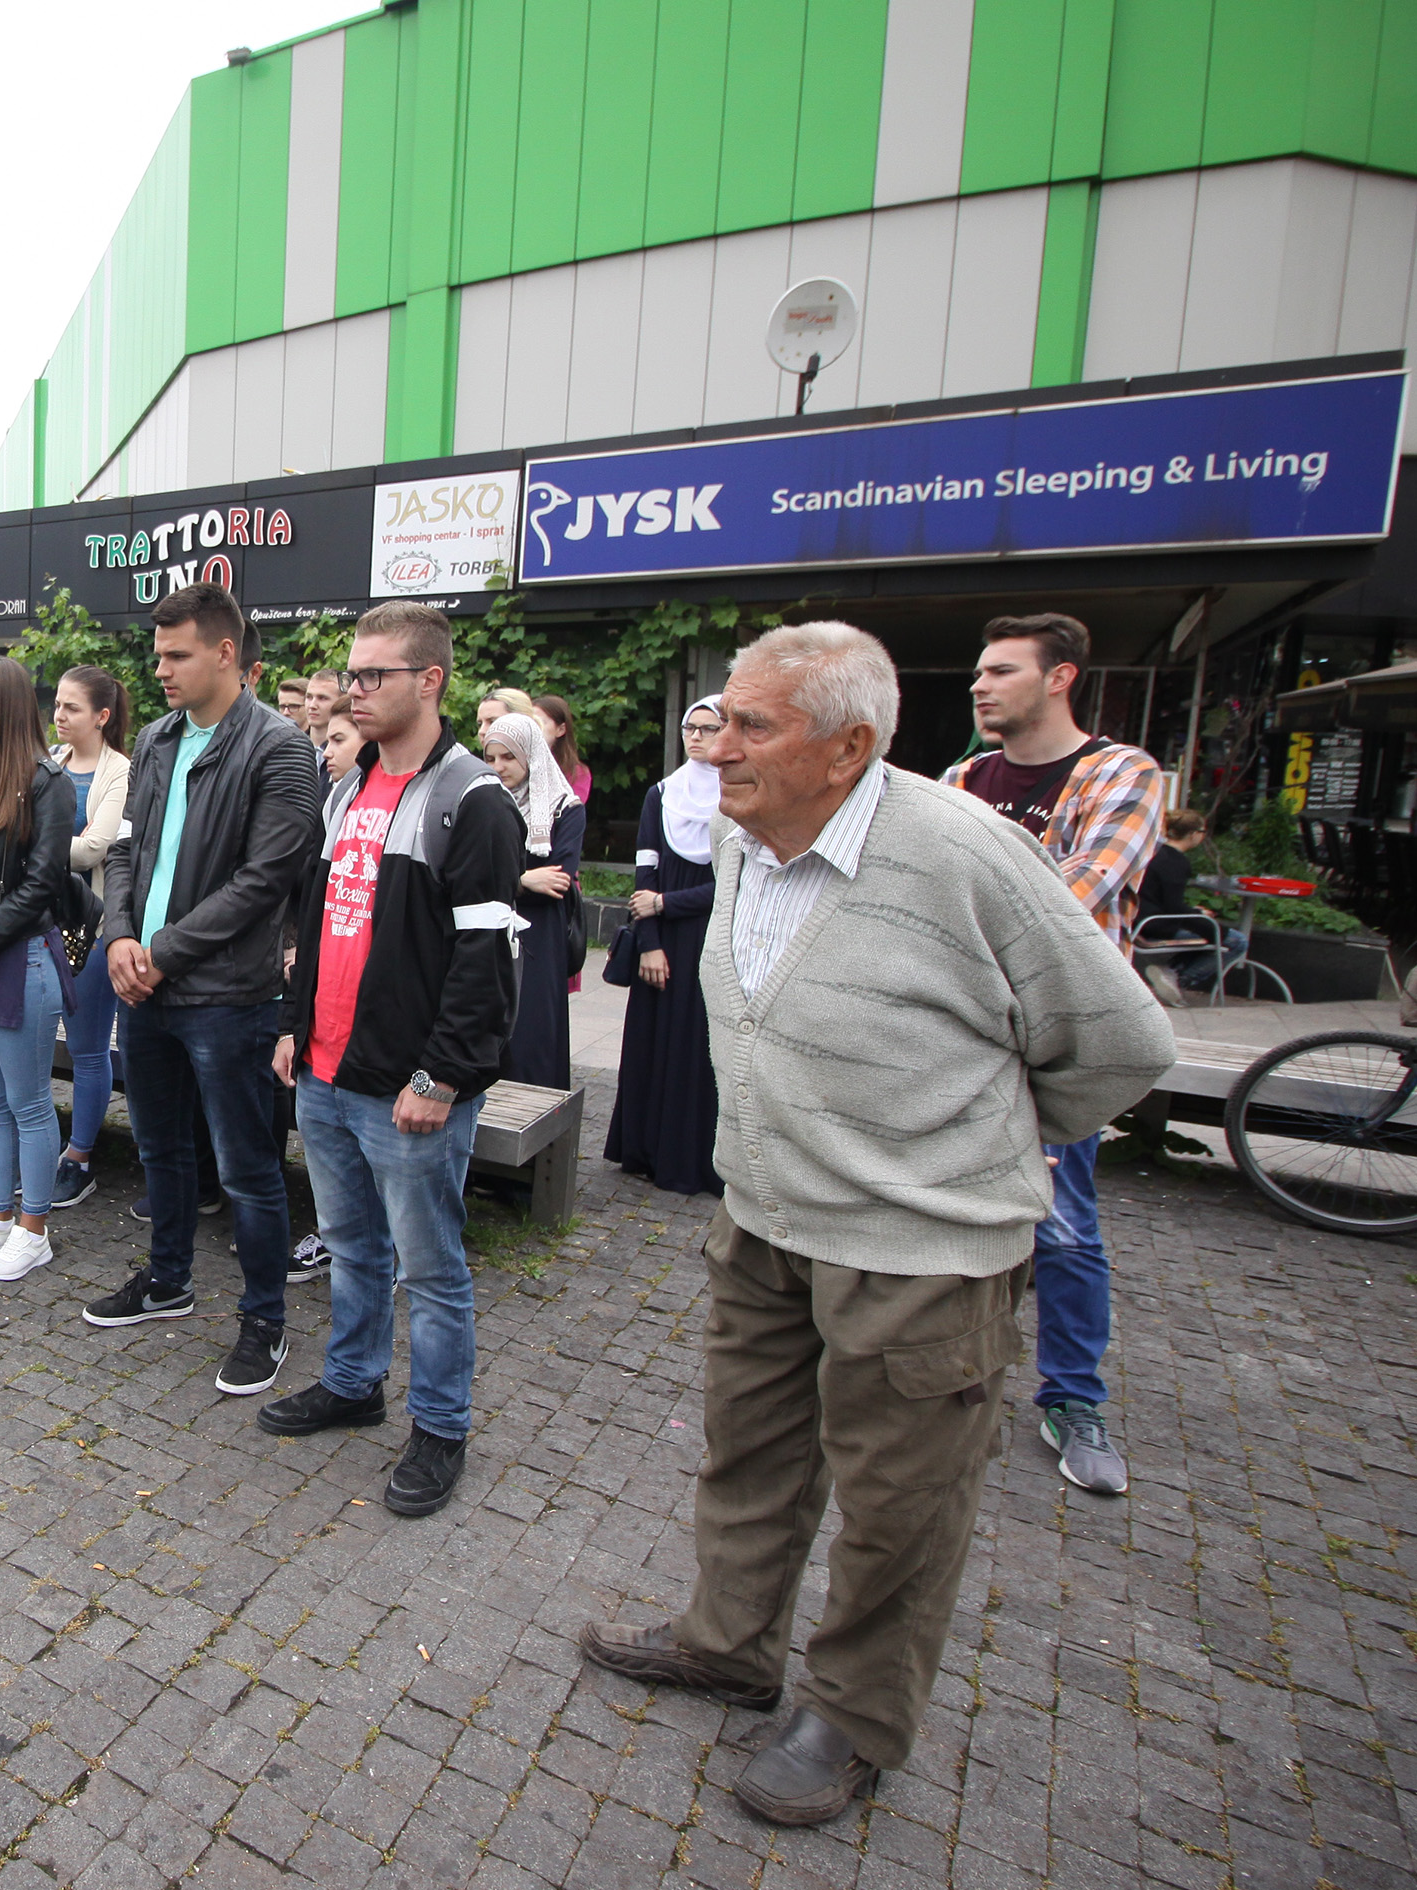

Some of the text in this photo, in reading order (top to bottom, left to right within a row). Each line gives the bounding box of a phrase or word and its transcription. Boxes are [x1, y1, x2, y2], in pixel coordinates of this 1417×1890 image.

[385, 482, 505, 528] JASKO
[770, 448, 1329, 515] Scandinavian Sleeping & Living
[381, 535, 393, 545] VF
[394, 532, 433, 545] shopping
[433, 530, 461, 541] centar
[476, 525, 505, 539] sprat
[563, 483, 724, 541] JYSK
[85, 507, 293, 569] TRATTORIA
[133, 554, 233, 604] UNO
[391, 563, 431, 581] ILEA
[250, 608, 292, 622] Opušteno
